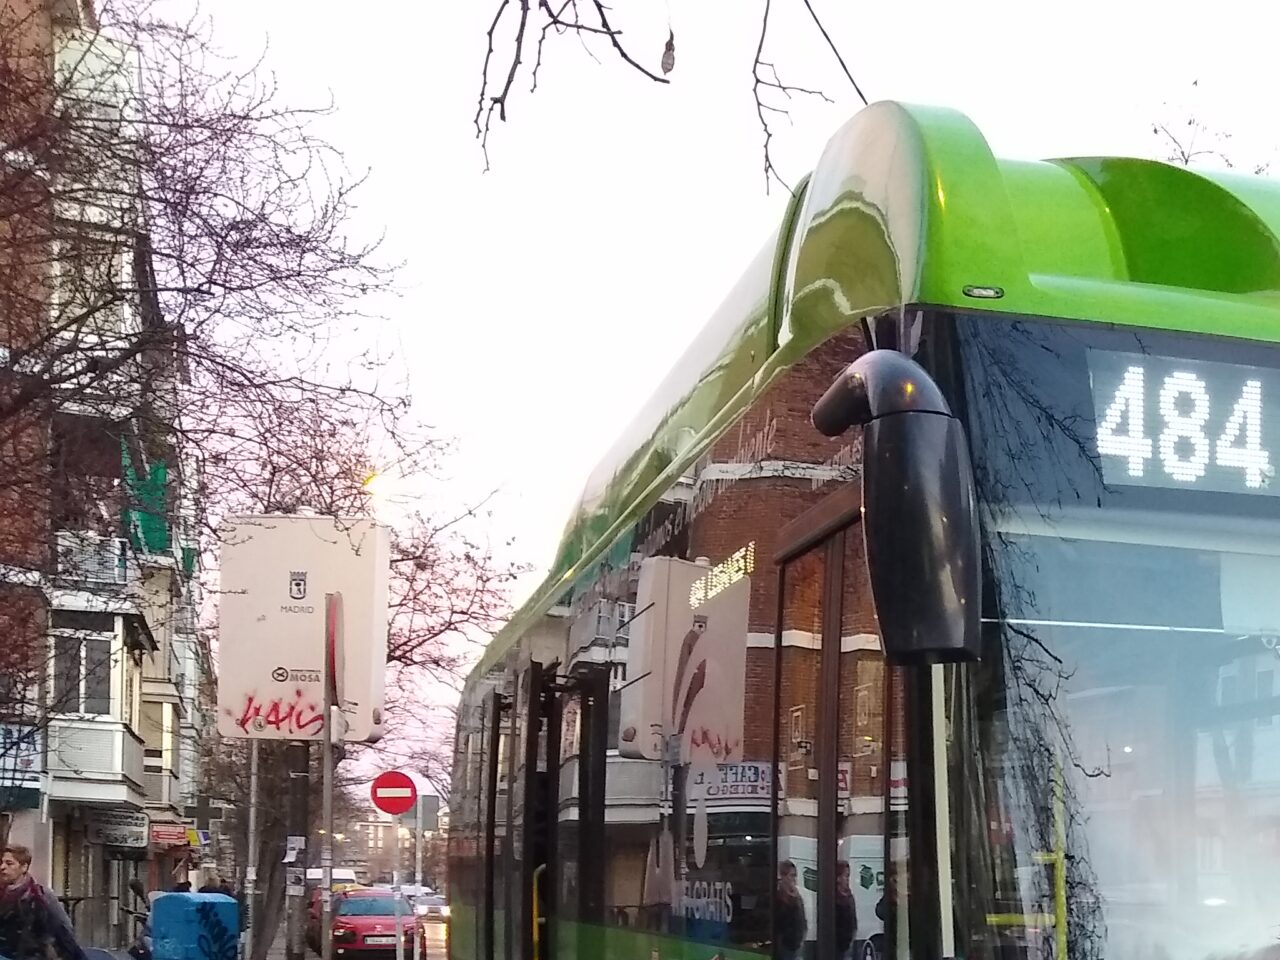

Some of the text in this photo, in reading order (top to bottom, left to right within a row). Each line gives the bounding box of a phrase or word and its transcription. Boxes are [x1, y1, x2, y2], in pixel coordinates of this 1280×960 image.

[1096, 366, 1271, 488] 484
[280, 605, 314, 614] MADRID
[290, 674, 321, 683] MOSA
